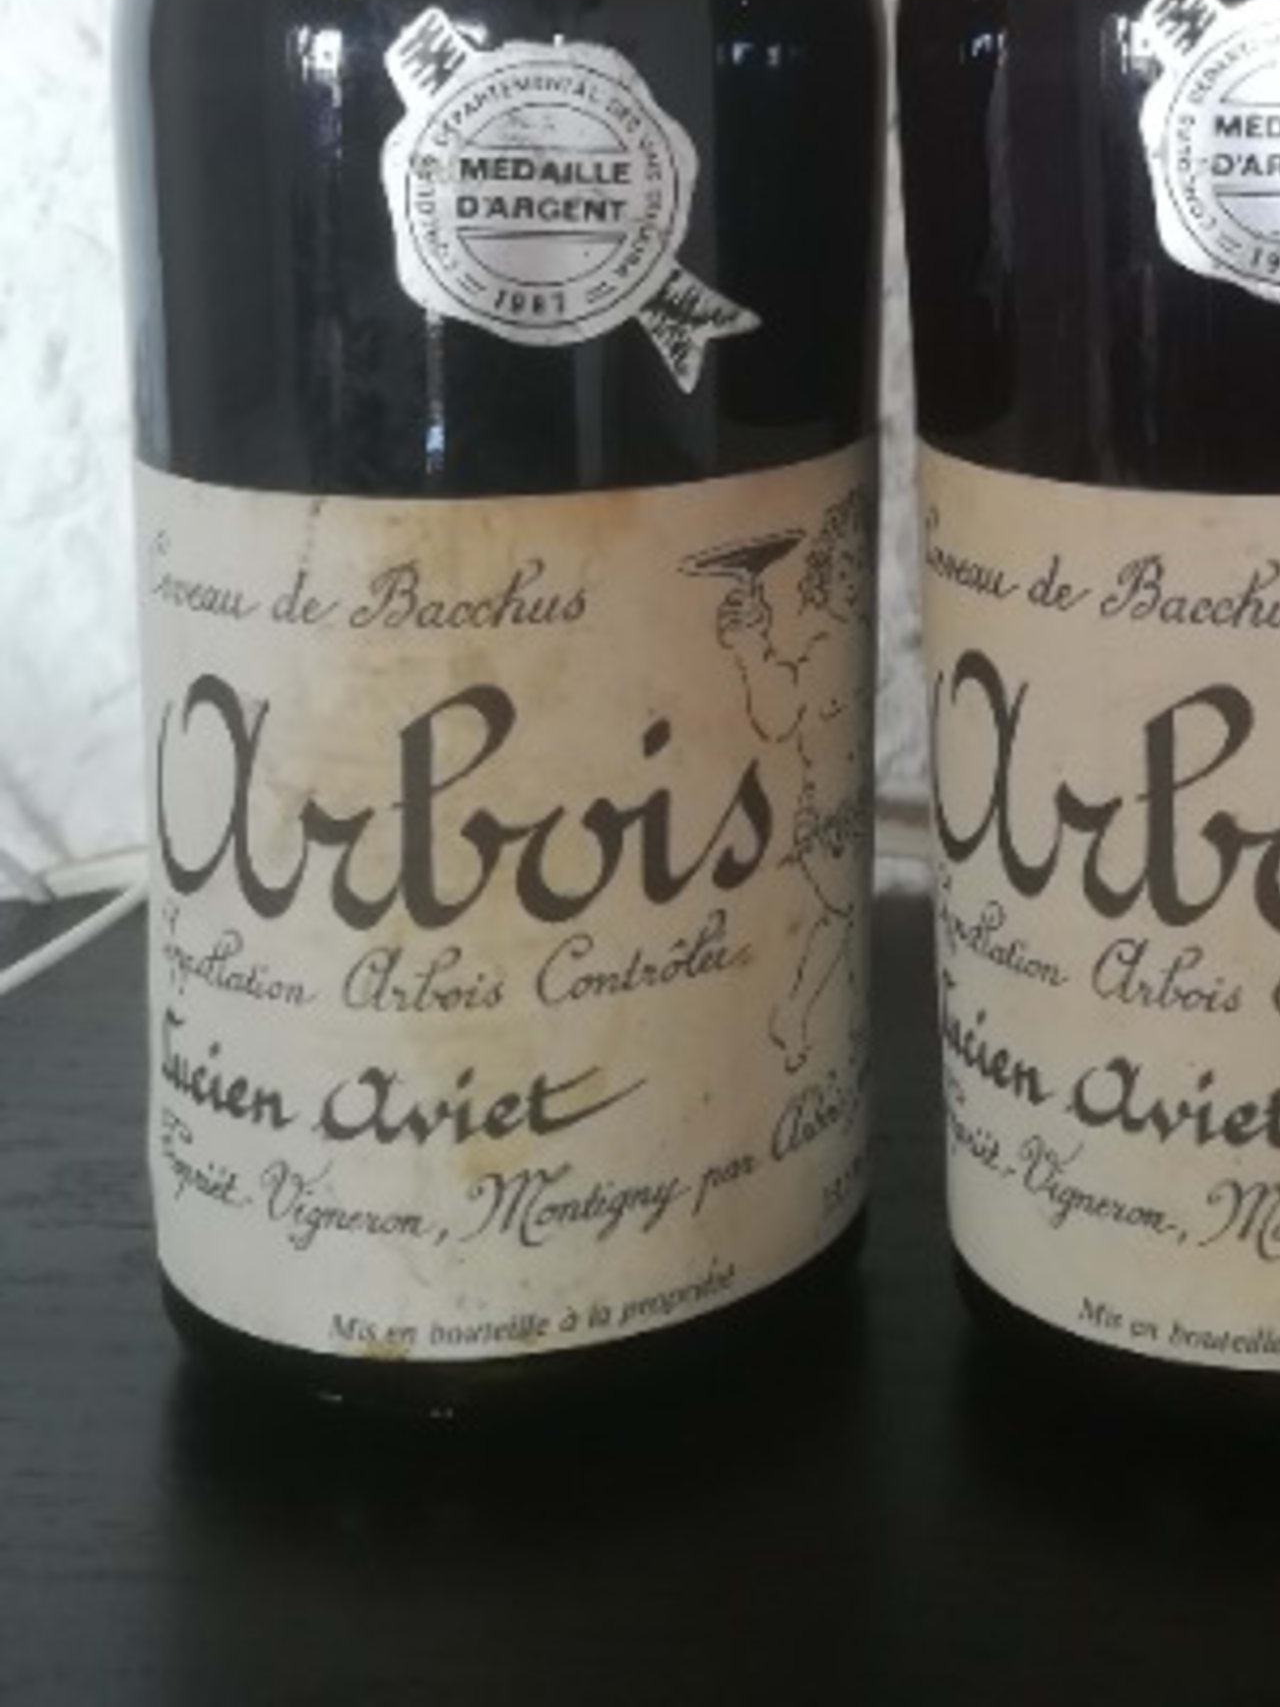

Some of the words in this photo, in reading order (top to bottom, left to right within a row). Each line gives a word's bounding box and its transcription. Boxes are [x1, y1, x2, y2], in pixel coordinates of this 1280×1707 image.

[456, 195, 628, 222] D'ARGENT
[271, 567, 341, 624] de
[348, 558, 588, 631] Bacchus
[1027, 554, 1093, 612] de
[157, 672, 774, 931] Arbois
[342, 940, 505, 1012] Arbois
[1091, 937, 1242, 1014] Arbois
[312, 1064, 648, 1146] Aviet
[460, 1161, 691, 1247] Montigny
[698, 1157, 761, 1212] par
[329, 1313, 377, 1342] Mis
[387, 1325, 416, 1343] en
[430, 1314, 551, 1345] bouteille
[558, 1306, 580, 1332] à
[587, 1304, 611, 1329] la
[1077, 1296, 1123, 1329] Mis
[1129, 1320, 1160, 1341] en
